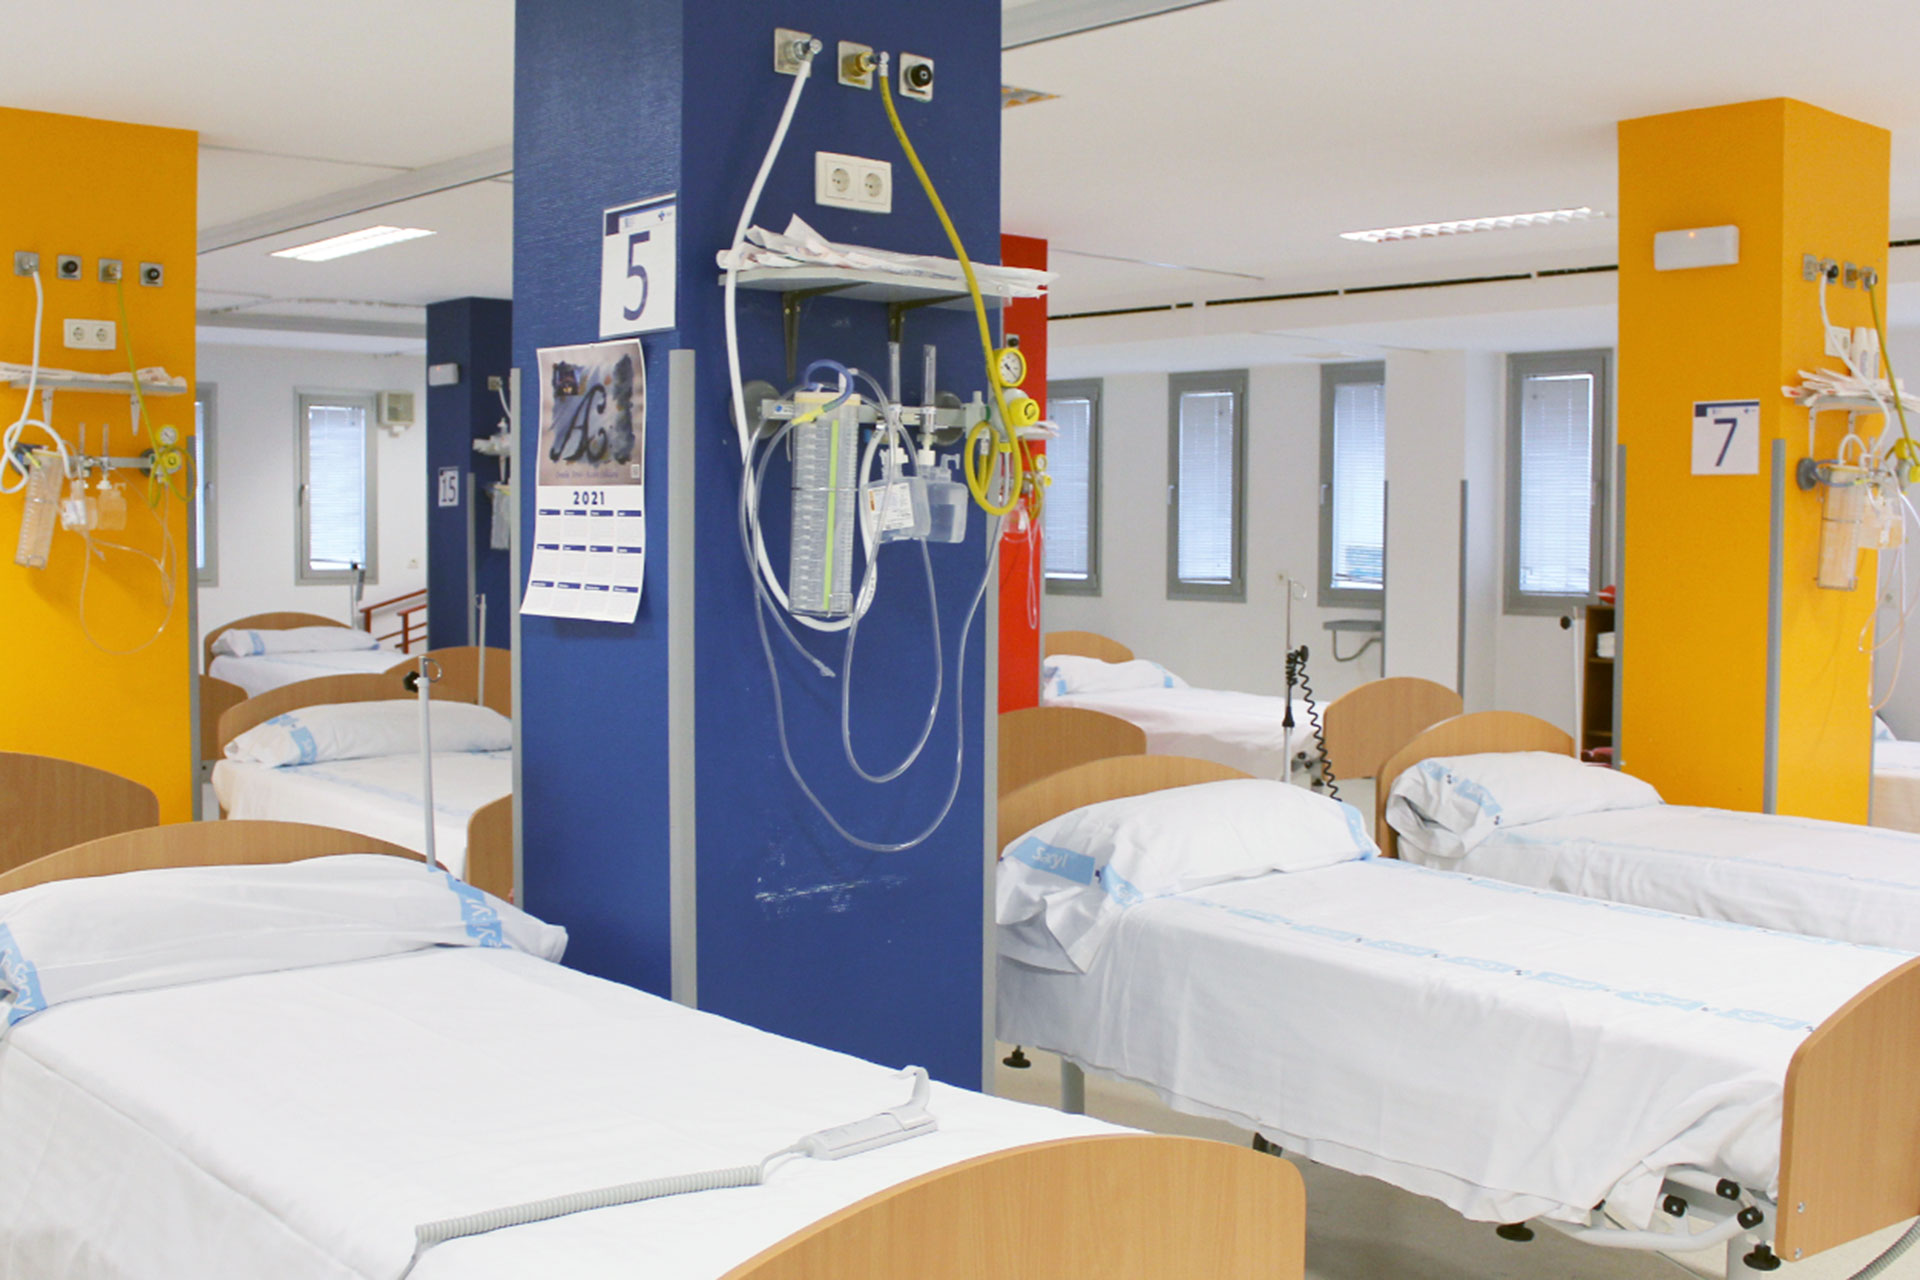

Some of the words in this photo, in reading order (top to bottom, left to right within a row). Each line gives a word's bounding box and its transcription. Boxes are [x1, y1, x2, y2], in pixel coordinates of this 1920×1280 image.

[623, 230, 651, 321] 5
[1713, 417, 1738, 467] 7
[441, 476, 457, 503] 15
[573, 491, 605, 505] 2021
